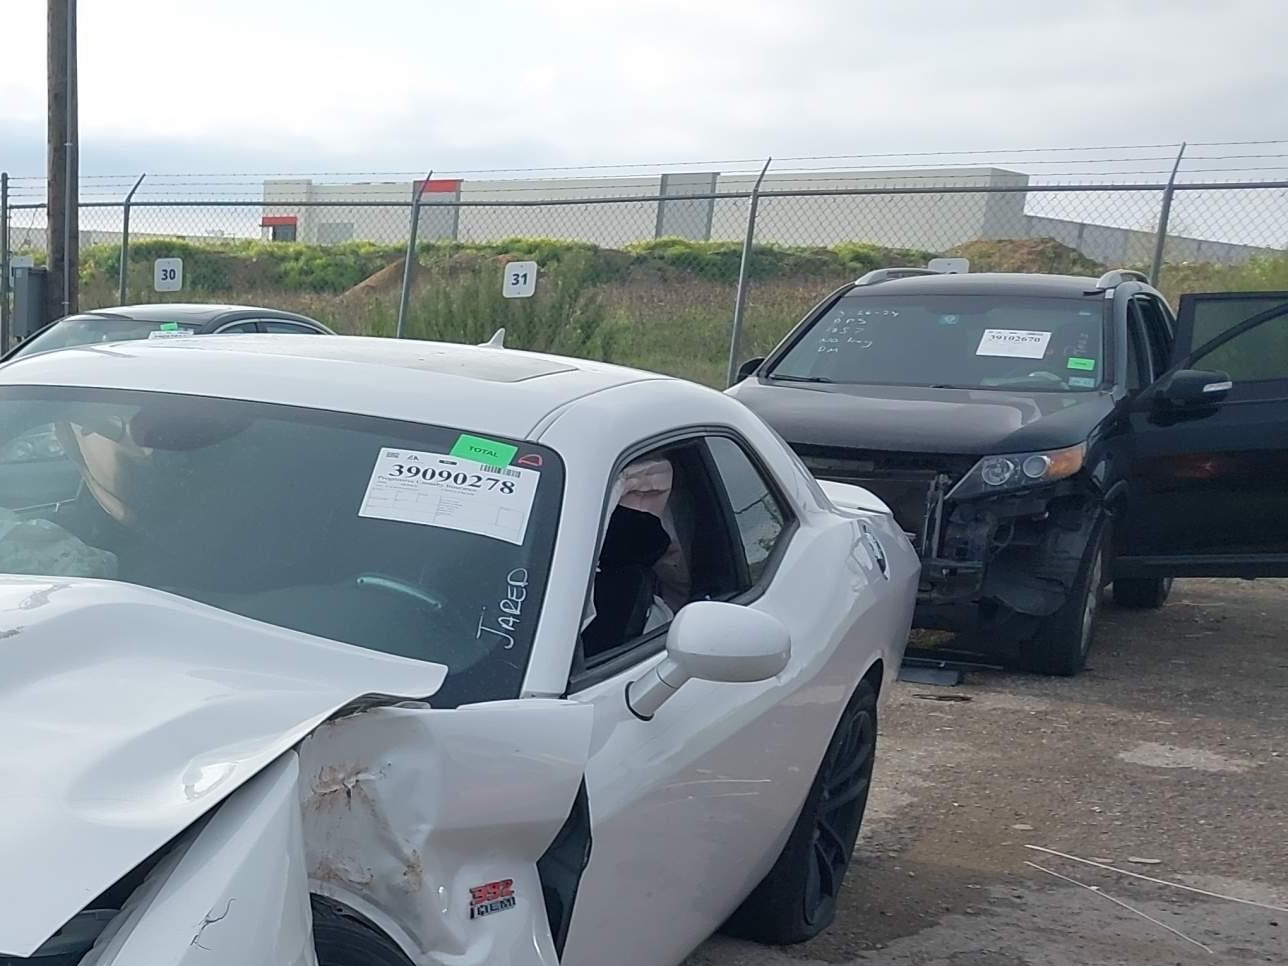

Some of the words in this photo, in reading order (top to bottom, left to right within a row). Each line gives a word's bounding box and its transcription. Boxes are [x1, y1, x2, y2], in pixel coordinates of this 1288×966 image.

[160, 269, 177, 281] 30
[511, 273, 528, 286] 31
[469, 445, 499, 458] TOTAL
[388, 464, 516, 495] 39090278
[476, 567, 529, 650] JARED
